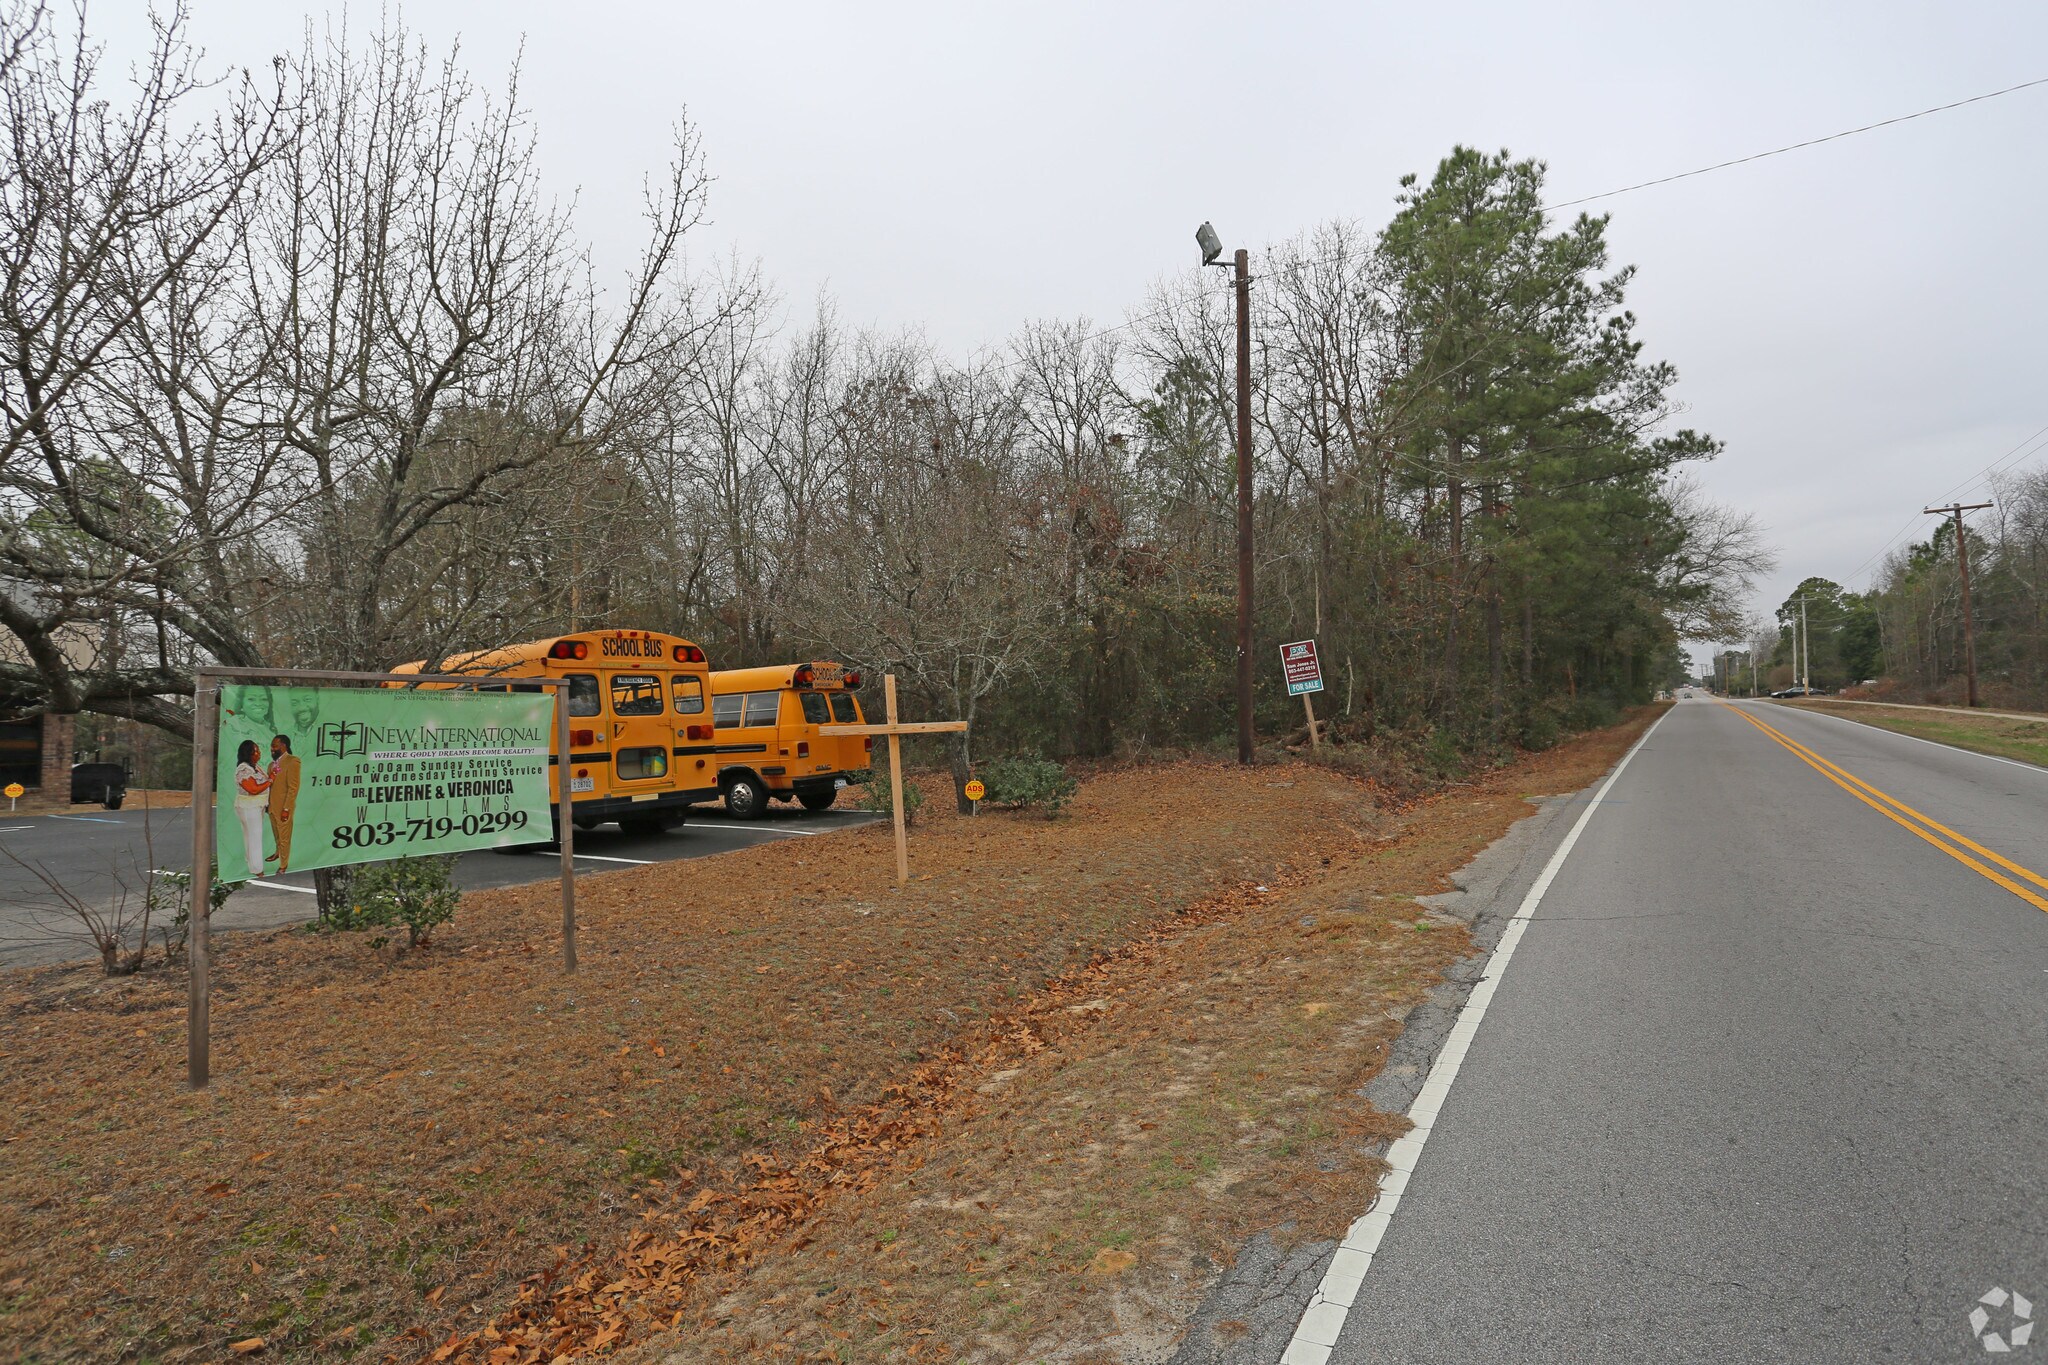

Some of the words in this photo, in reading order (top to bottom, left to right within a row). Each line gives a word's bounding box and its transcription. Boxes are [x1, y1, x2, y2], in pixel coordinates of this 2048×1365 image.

[602, 637, 641, 656] SCHOOL
[644, 639, 662, 657] BUS
[1293, 683, 1305, 692] FOR
[1305, 681, 1319, 690] SALE
[368, 726, 416, 744] NEW
[420, 726, 541, 743] INTERNATIONAL
[401, 741, 449, 750] DREAM
[463, 740, 515, 748] CENTER
[374, 751, 408, 759] WHERE
[355, 762, 414, 774] 10:00am
[421, 760, 463, 771] Sunday
[469, 758, 512, 769] Service
[312, 774, 363, 787] 7:00pm
[370, 770, 446, 783] Wednesday
[451, 768, 498, 779] Evening
[503, 766, 543, 776] Service
[352, 787, 367, 799] DR.
[367, 784, 432, 804] LEVERNE
[435, 785, 445, 800] &
[447, 779, 514, 798] VERONICA
[356, 795, 510, 823] WILLIAMS
[331, 810, 528, 849] 803-719-0299
